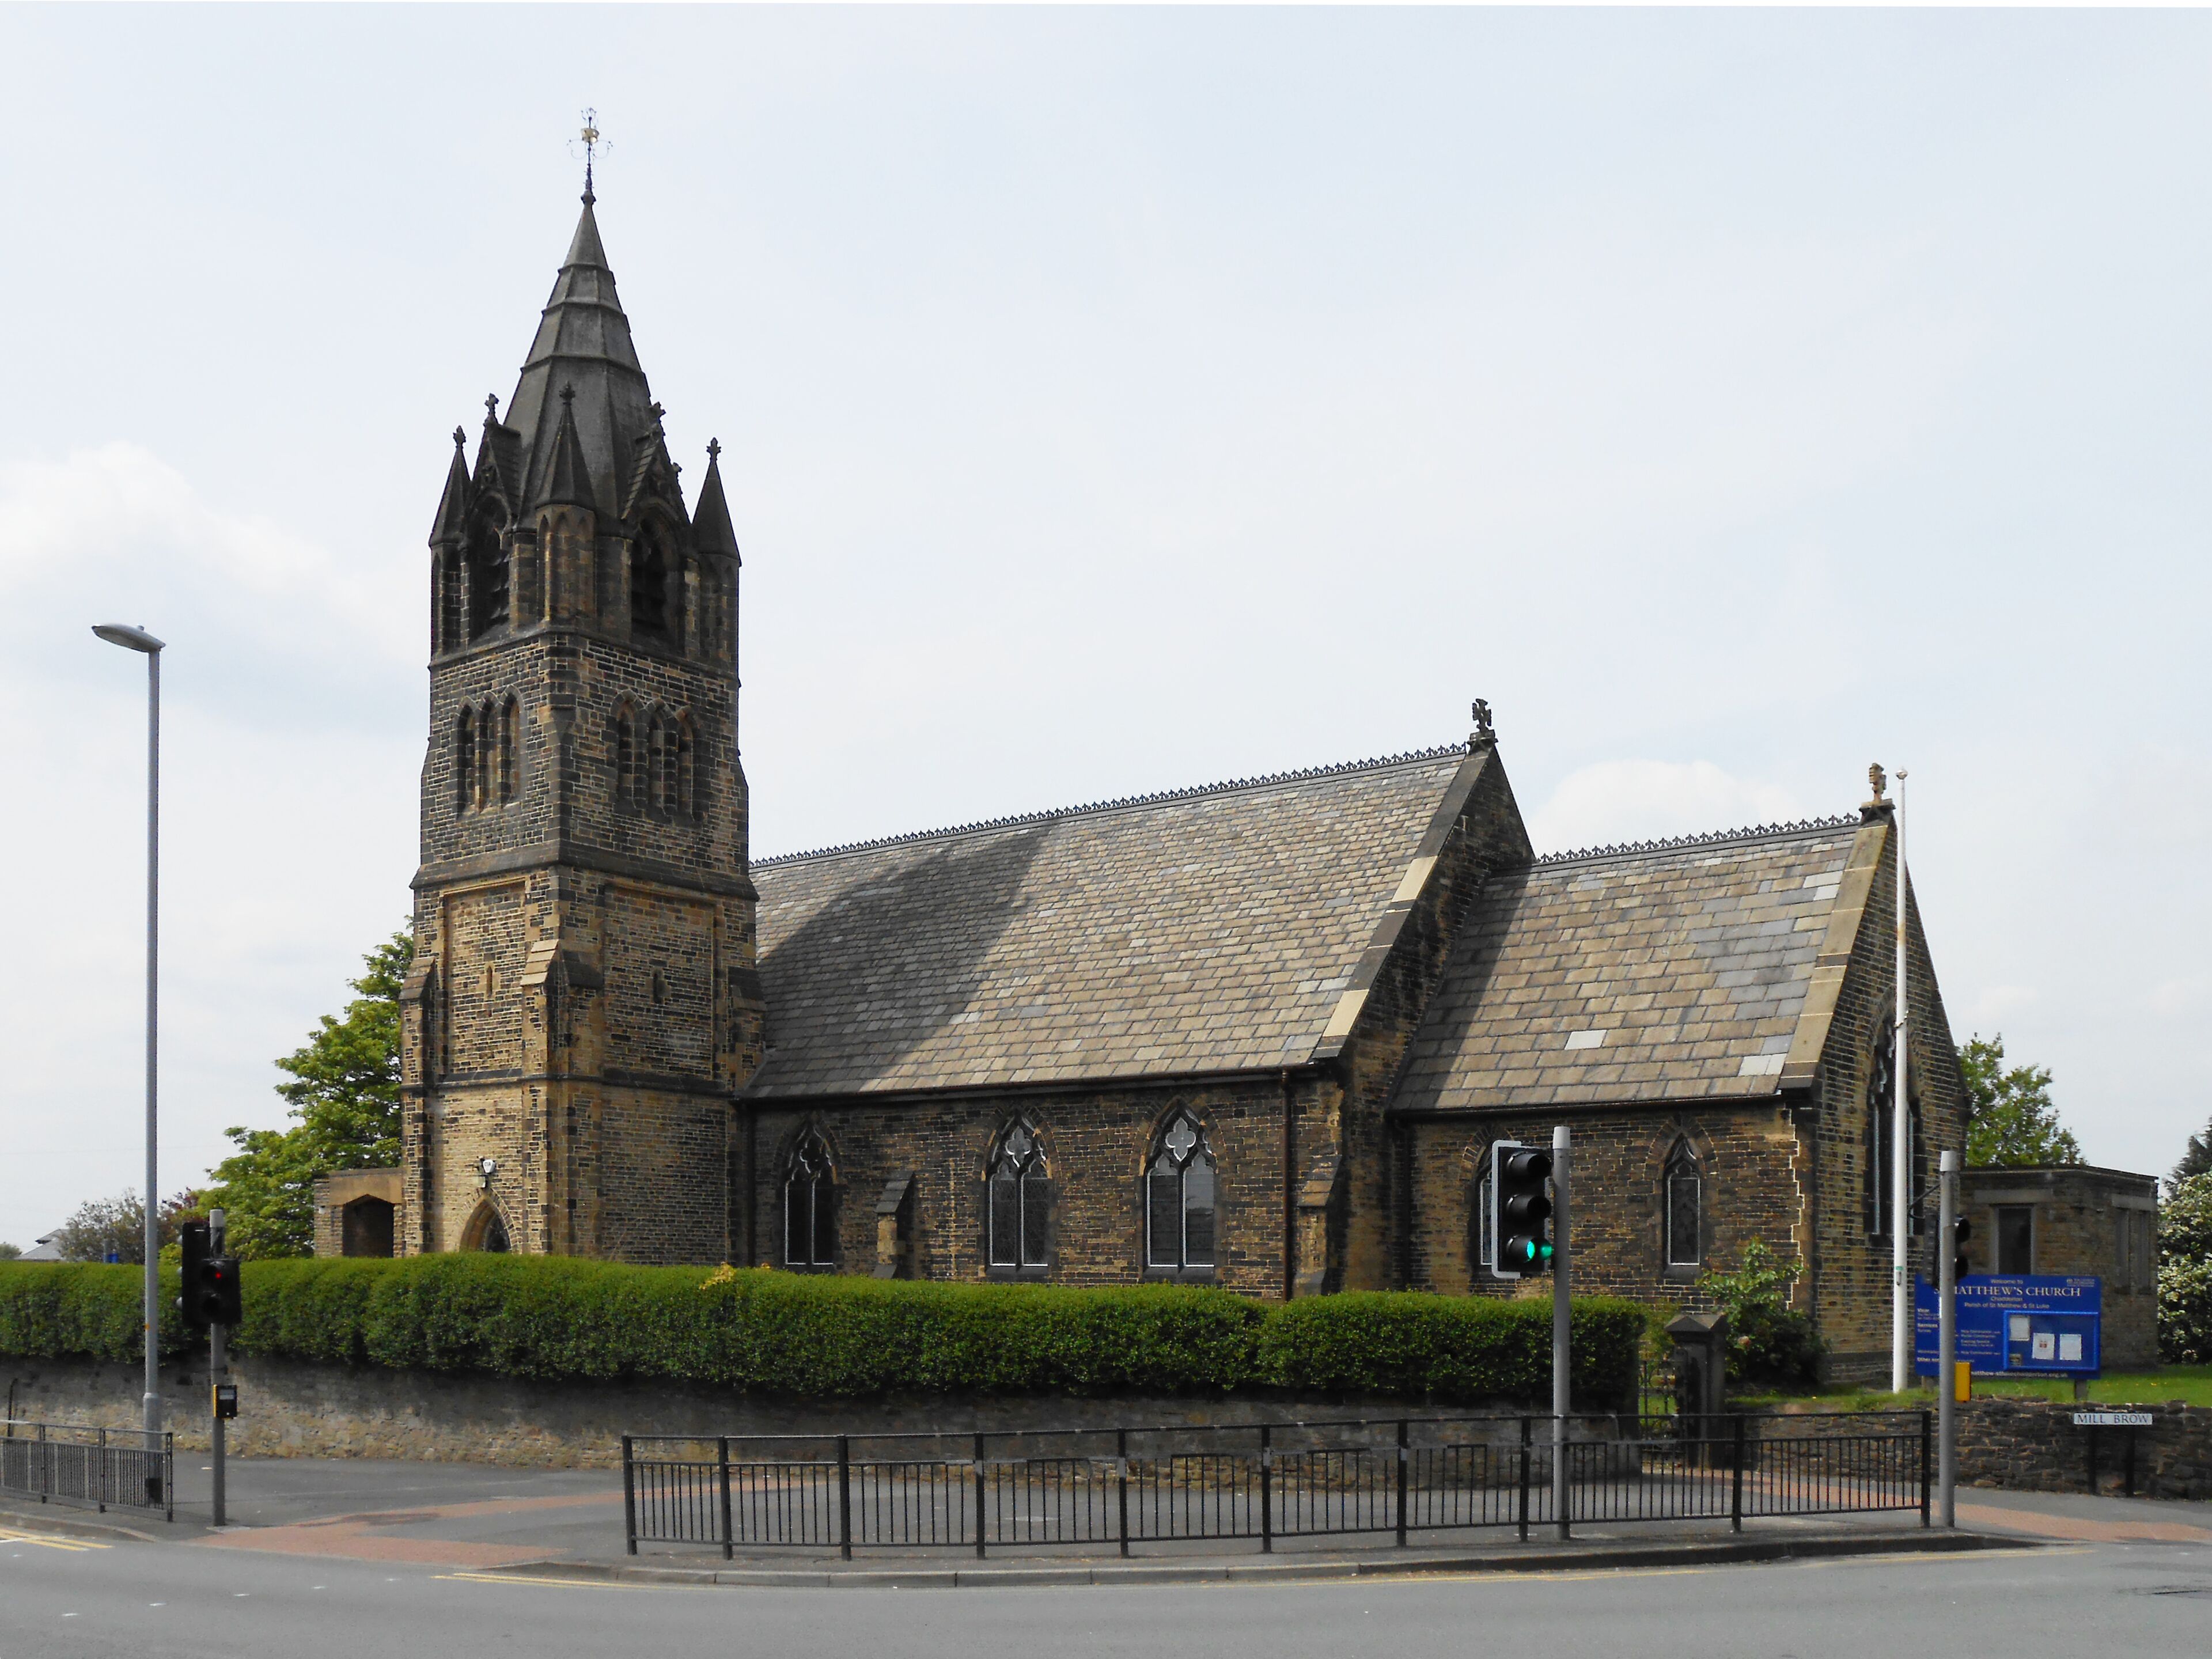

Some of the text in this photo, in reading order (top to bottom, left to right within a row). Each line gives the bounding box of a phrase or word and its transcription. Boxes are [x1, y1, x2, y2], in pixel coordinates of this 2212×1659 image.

[2026, 1286, 2081, 1296] CHURCH
[2077, 1414, 2147, 1423] MILL BROW
